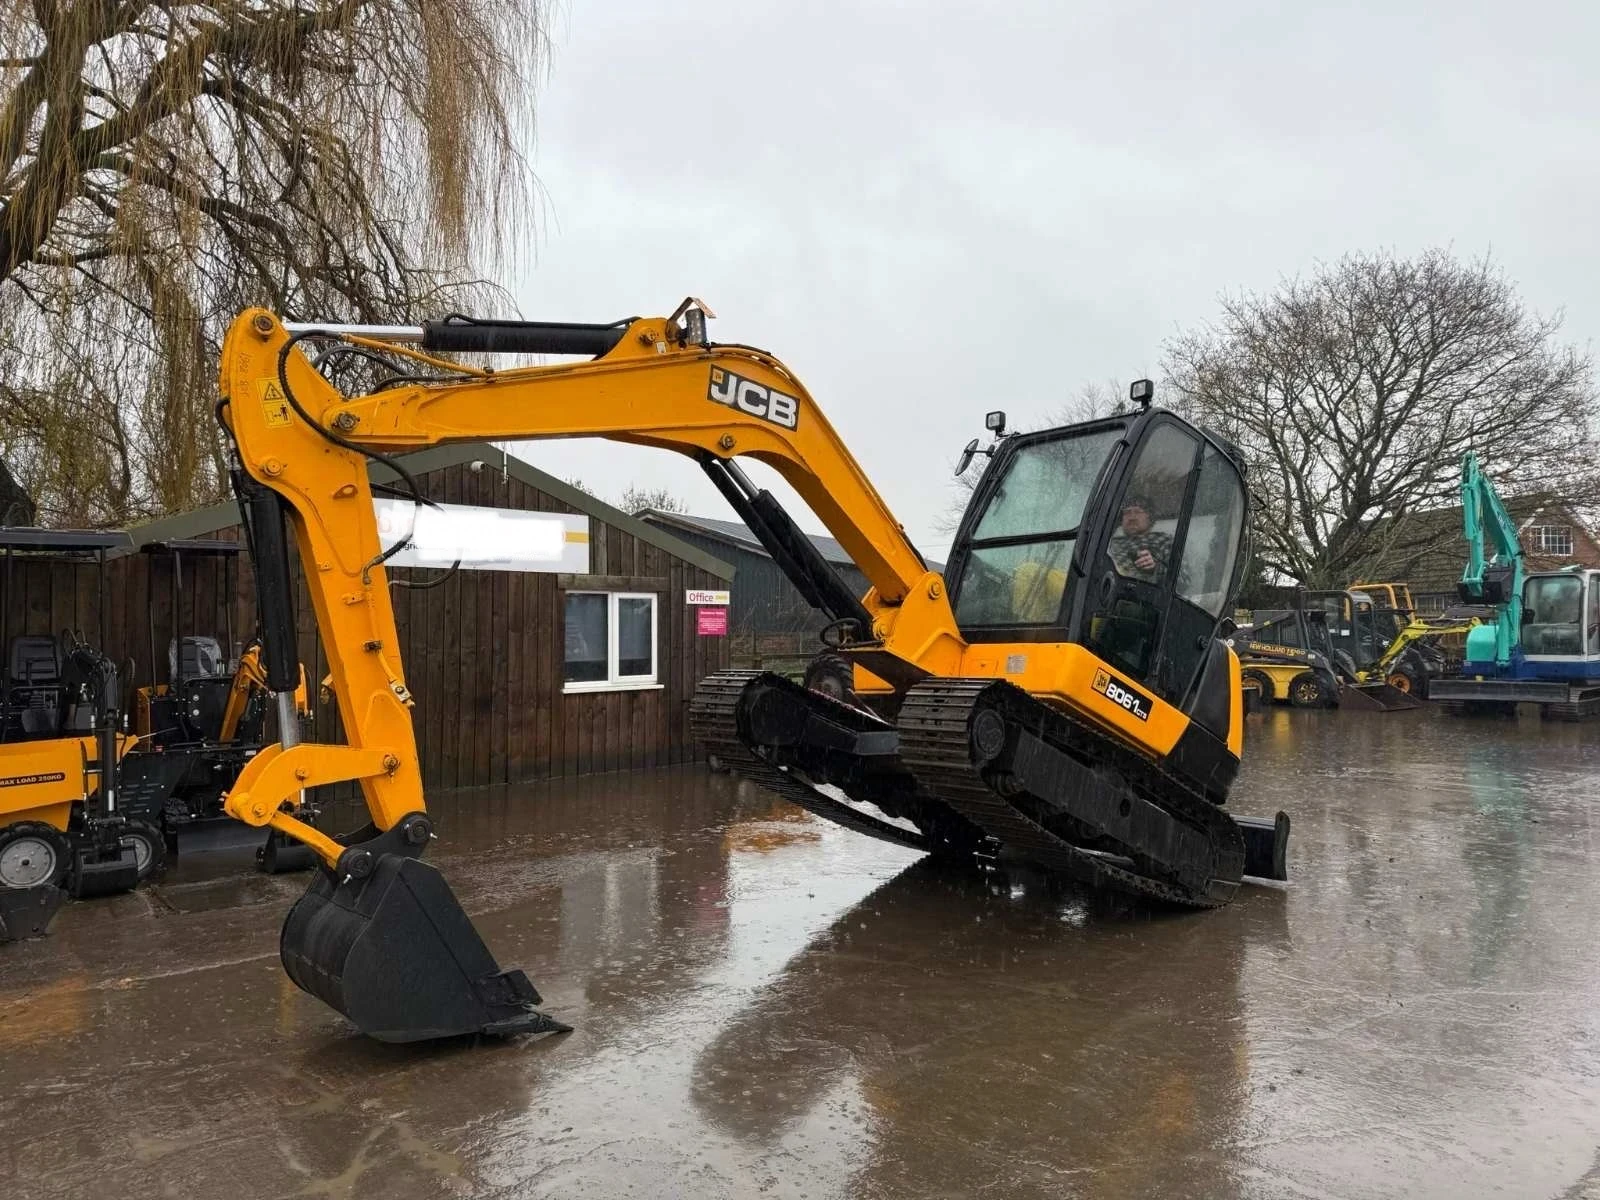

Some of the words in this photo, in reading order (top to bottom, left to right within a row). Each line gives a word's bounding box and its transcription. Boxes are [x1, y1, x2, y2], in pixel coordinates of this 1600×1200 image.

[710, 374, 797, 427] JCB
[689, 592, 714, 602] Office
[1261, 644, 1286, 654] HOLLAND
[1106, 683, 1140, 713] 8061
[16, 776, 37, 784] LOAD
[38, 774, 62, 782] 250KG
